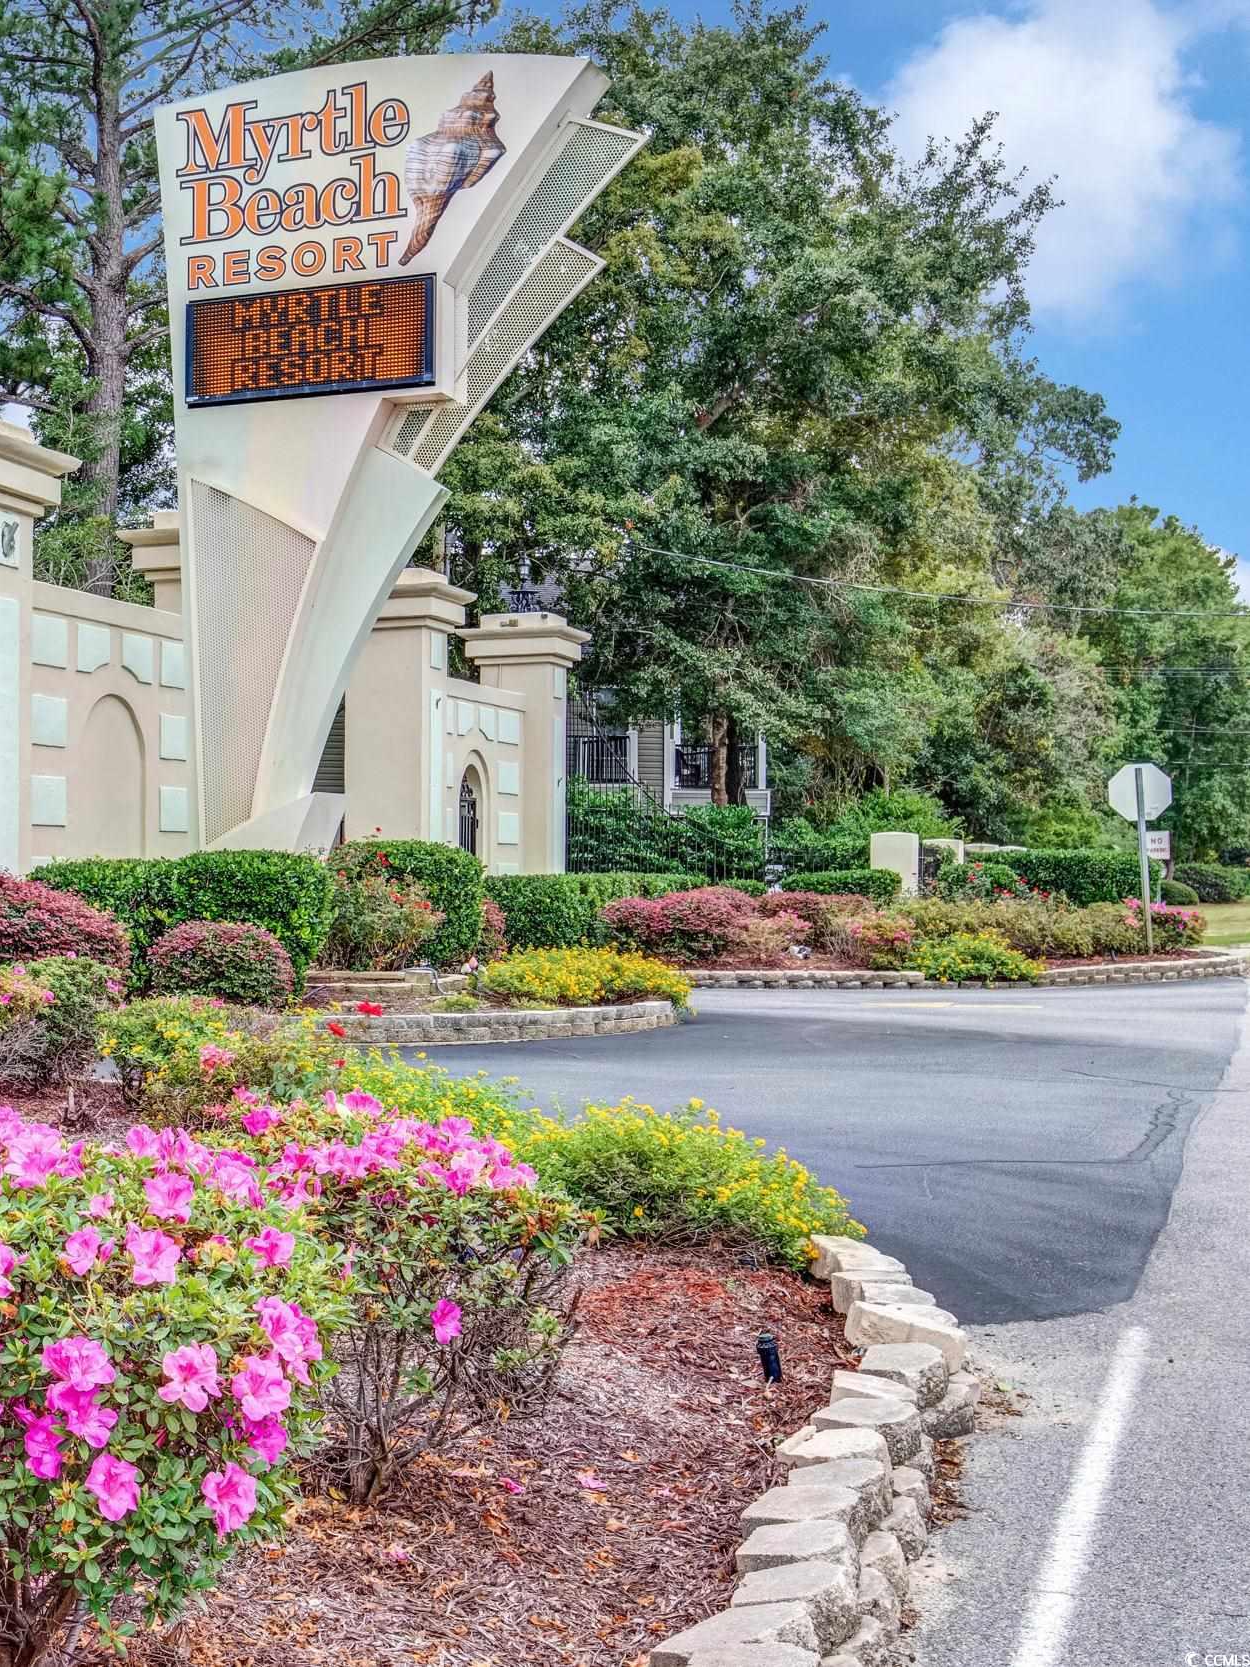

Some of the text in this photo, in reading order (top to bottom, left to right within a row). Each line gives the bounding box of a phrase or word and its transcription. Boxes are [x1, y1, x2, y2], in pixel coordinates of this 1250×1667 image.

[177, 82, 410, 184] Myrtle
[180, 152, 407, 247] Beach
[187, 231, 398, 289] RESORT
[234, 285, 383, 328] MYRTLE
[245, 320, 365, 358] BEACH
[234, 349, 381, 389] RESORT
[1150, 837, 1163, 845] NO
